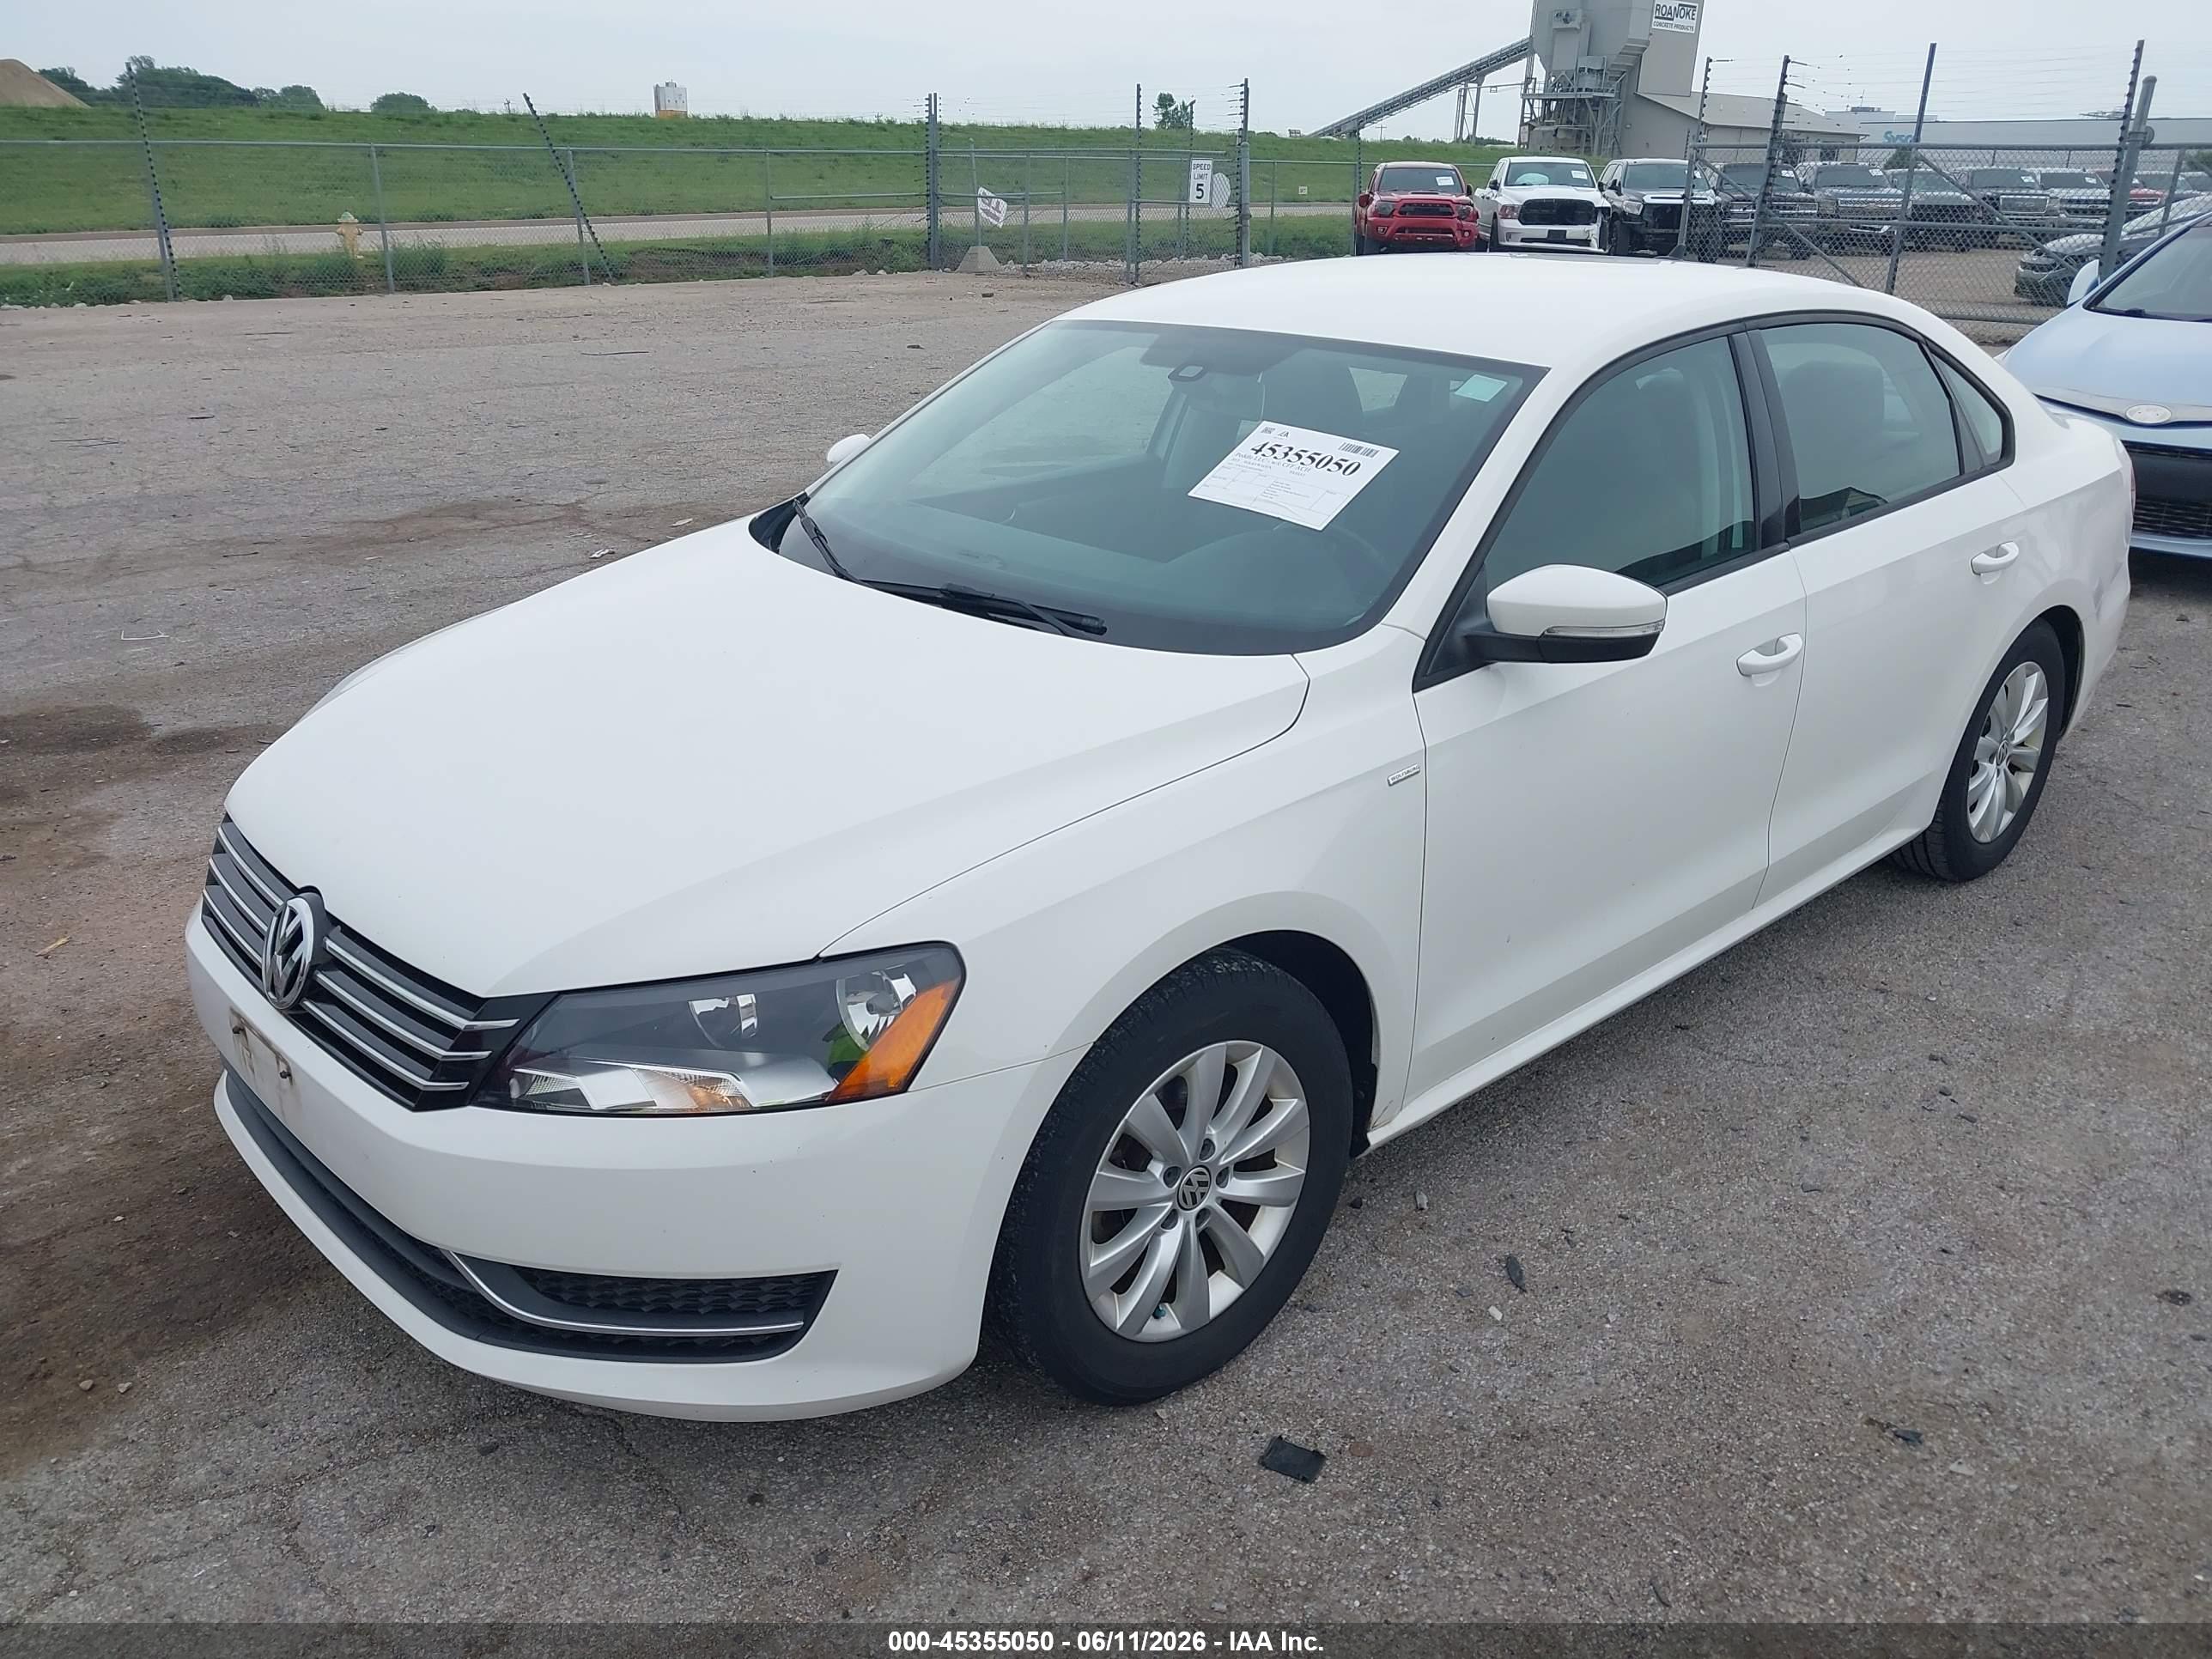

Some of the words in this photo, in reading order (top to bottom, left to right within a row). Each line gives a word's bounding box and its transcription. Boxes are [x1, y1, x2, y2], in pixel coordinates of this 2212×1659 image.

[1655, 3, 1697, 21] ROANOKE
[1674, 23, 1694, 32] PRODUCTS
[1194, 183, 1205, 199] 5
[1250, 441, 1363, 477] 45355050
